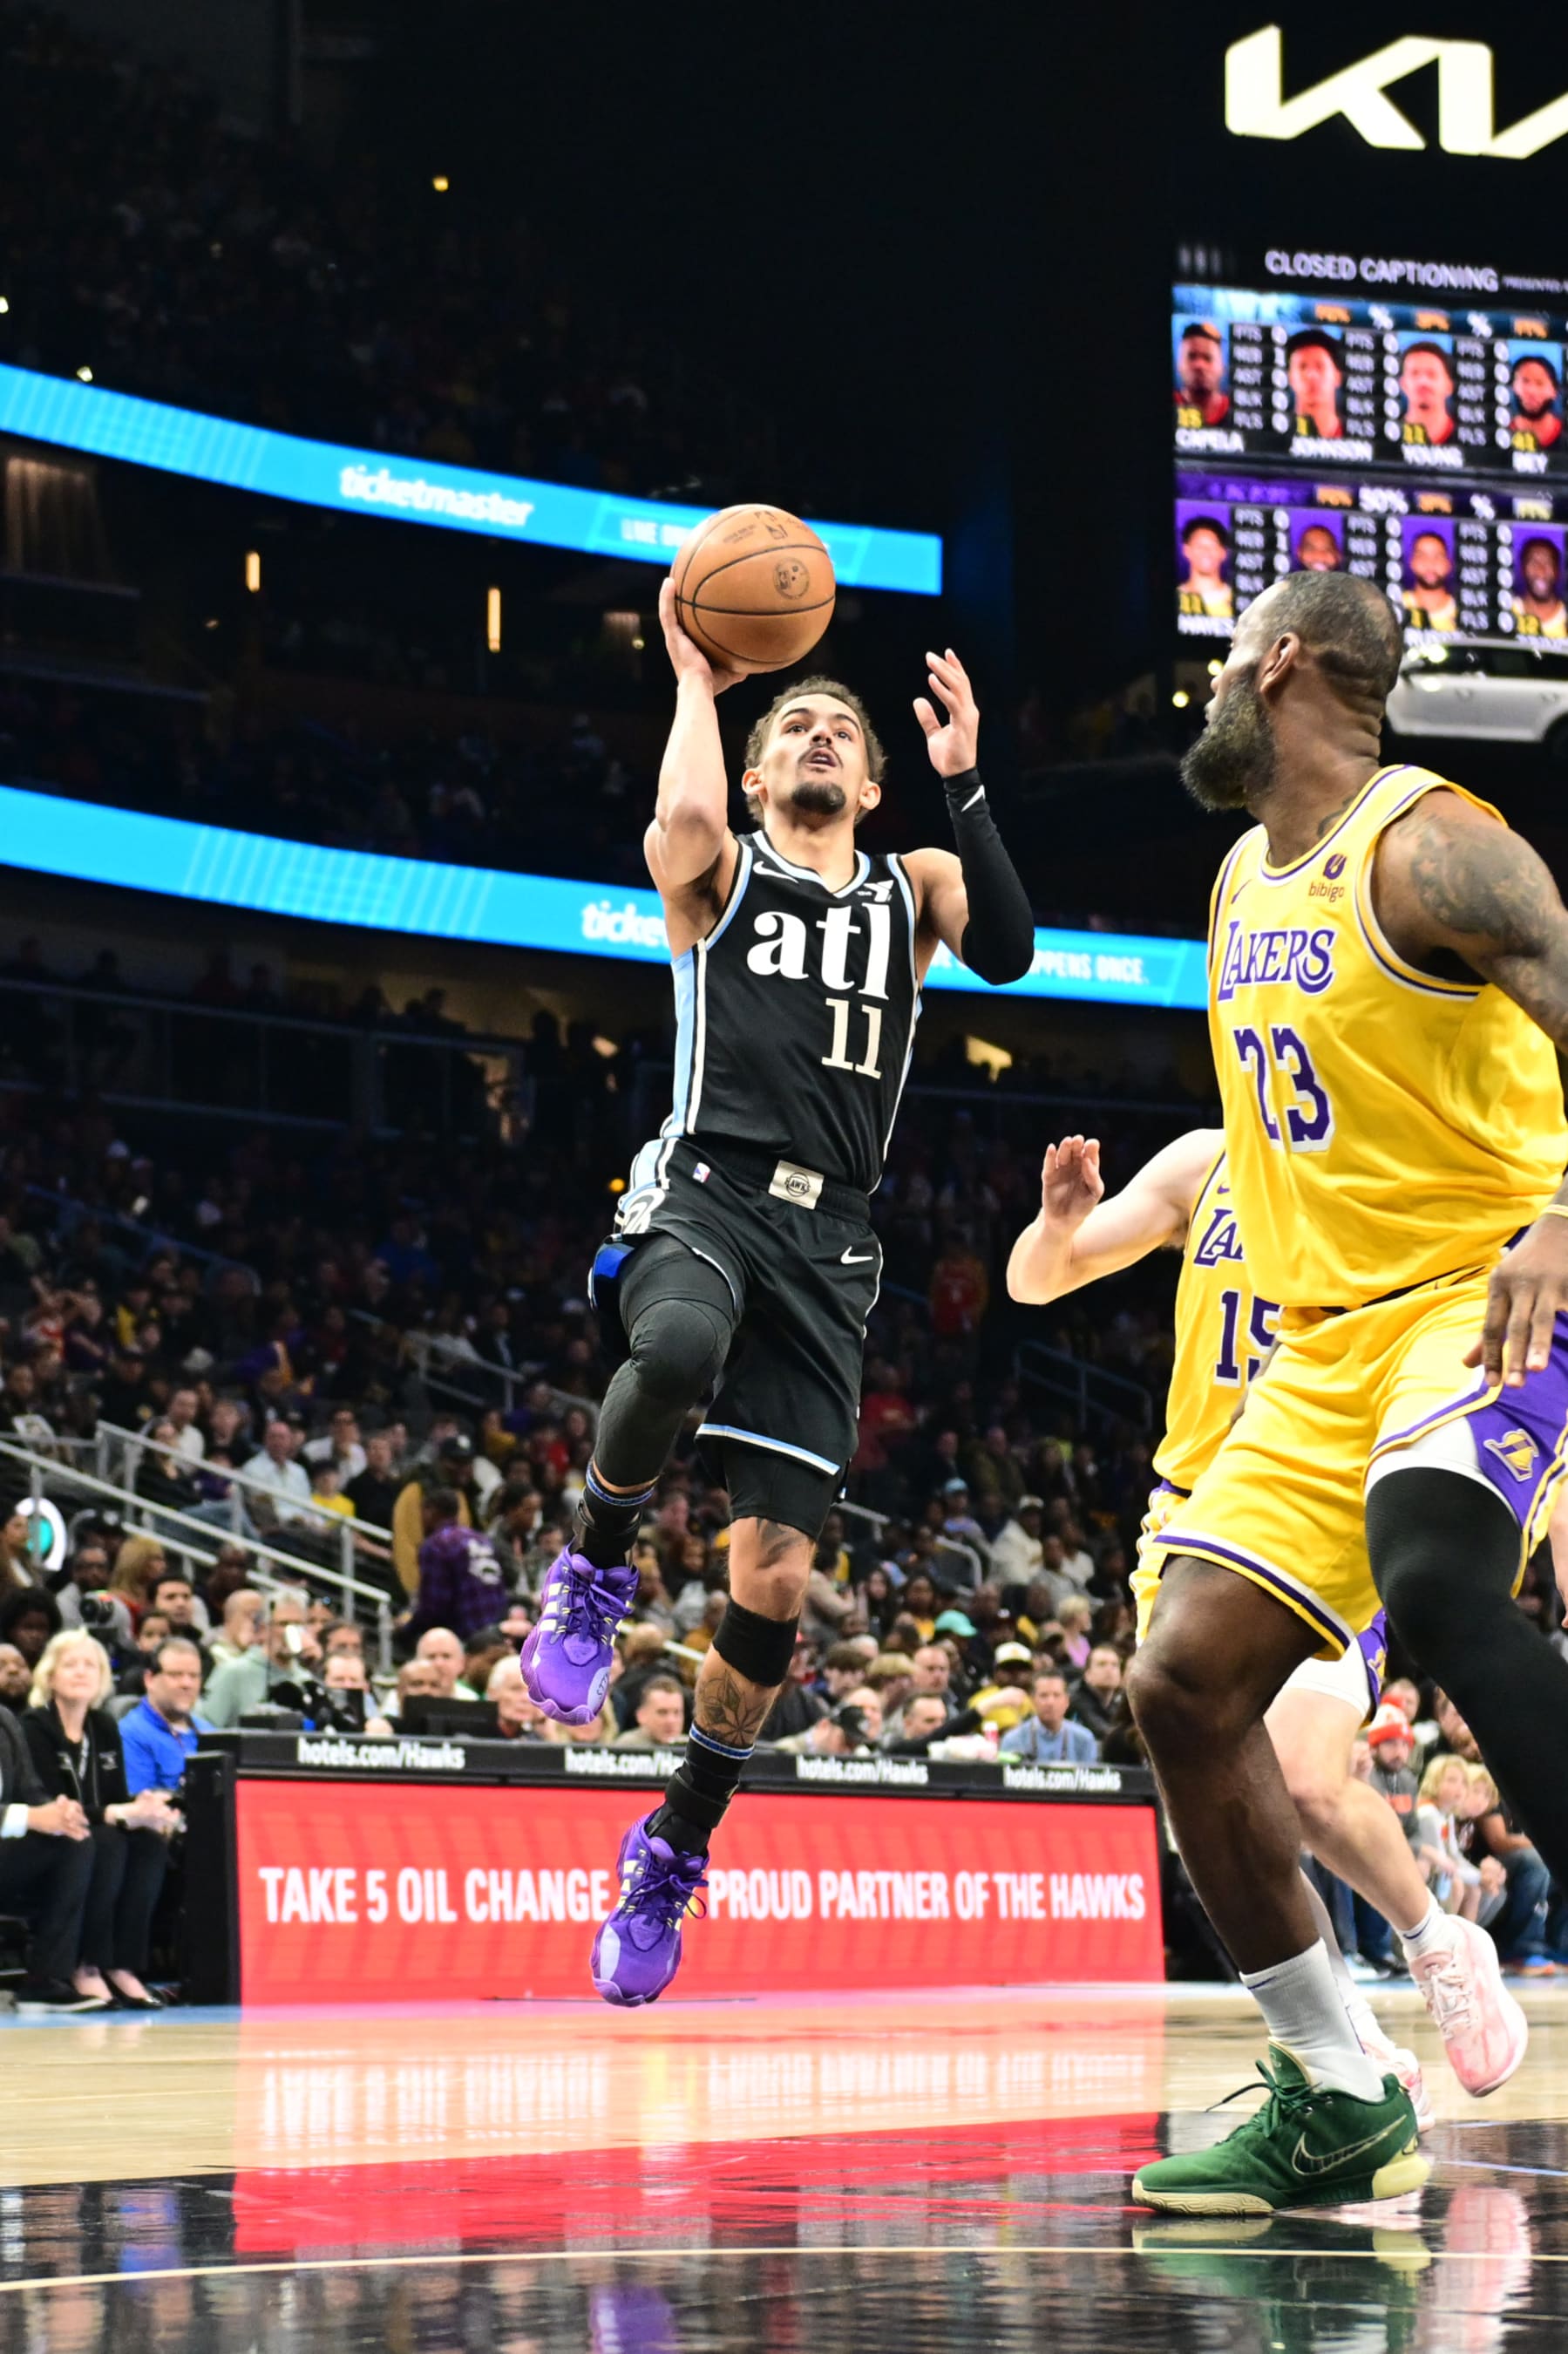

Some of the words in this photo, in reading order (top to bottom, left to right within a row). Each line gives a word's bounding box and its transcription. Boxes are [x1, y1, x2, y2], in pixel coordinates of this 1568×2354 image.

[1265, 250, 1356, 281] CLOSED
[1359, 257, 1499, 292] CAPTIONING
[339, 465, 533, 527] ticketmaster
[1308, 881, 1346, 903] bibigo
[581, 901, 670, 948] ticke
[746, 901, 890, 1001] atl
[1217, 920, 1338, 1003] LAKERS
[821, 997, 883, 1081] 11
[1232, 1022, 1334, 1152] 23
[297, 1737, 465, 1770] hotels.com/Hawks
[797, 1755, 929, 1786] hotels.com/Hawks
[1003, 1766, 1122, 1793] hotels.com/Hawks
[259, 1868, 356, 1923] TAKE
[366, 1870, 388, 1923] 5
[397, 1867, 458, 1923] OIL
[465, 1868, 609, 1923] CHANGE
[708, 1868, 812, 1921] PROUD
[818, 1870, 949, 1920] PARTNER
[954, 1872, 988, 1920] OF
[993, 1873, 1046, 1920] THE
[1050, 1874, 1145, 1921] HAWKS
